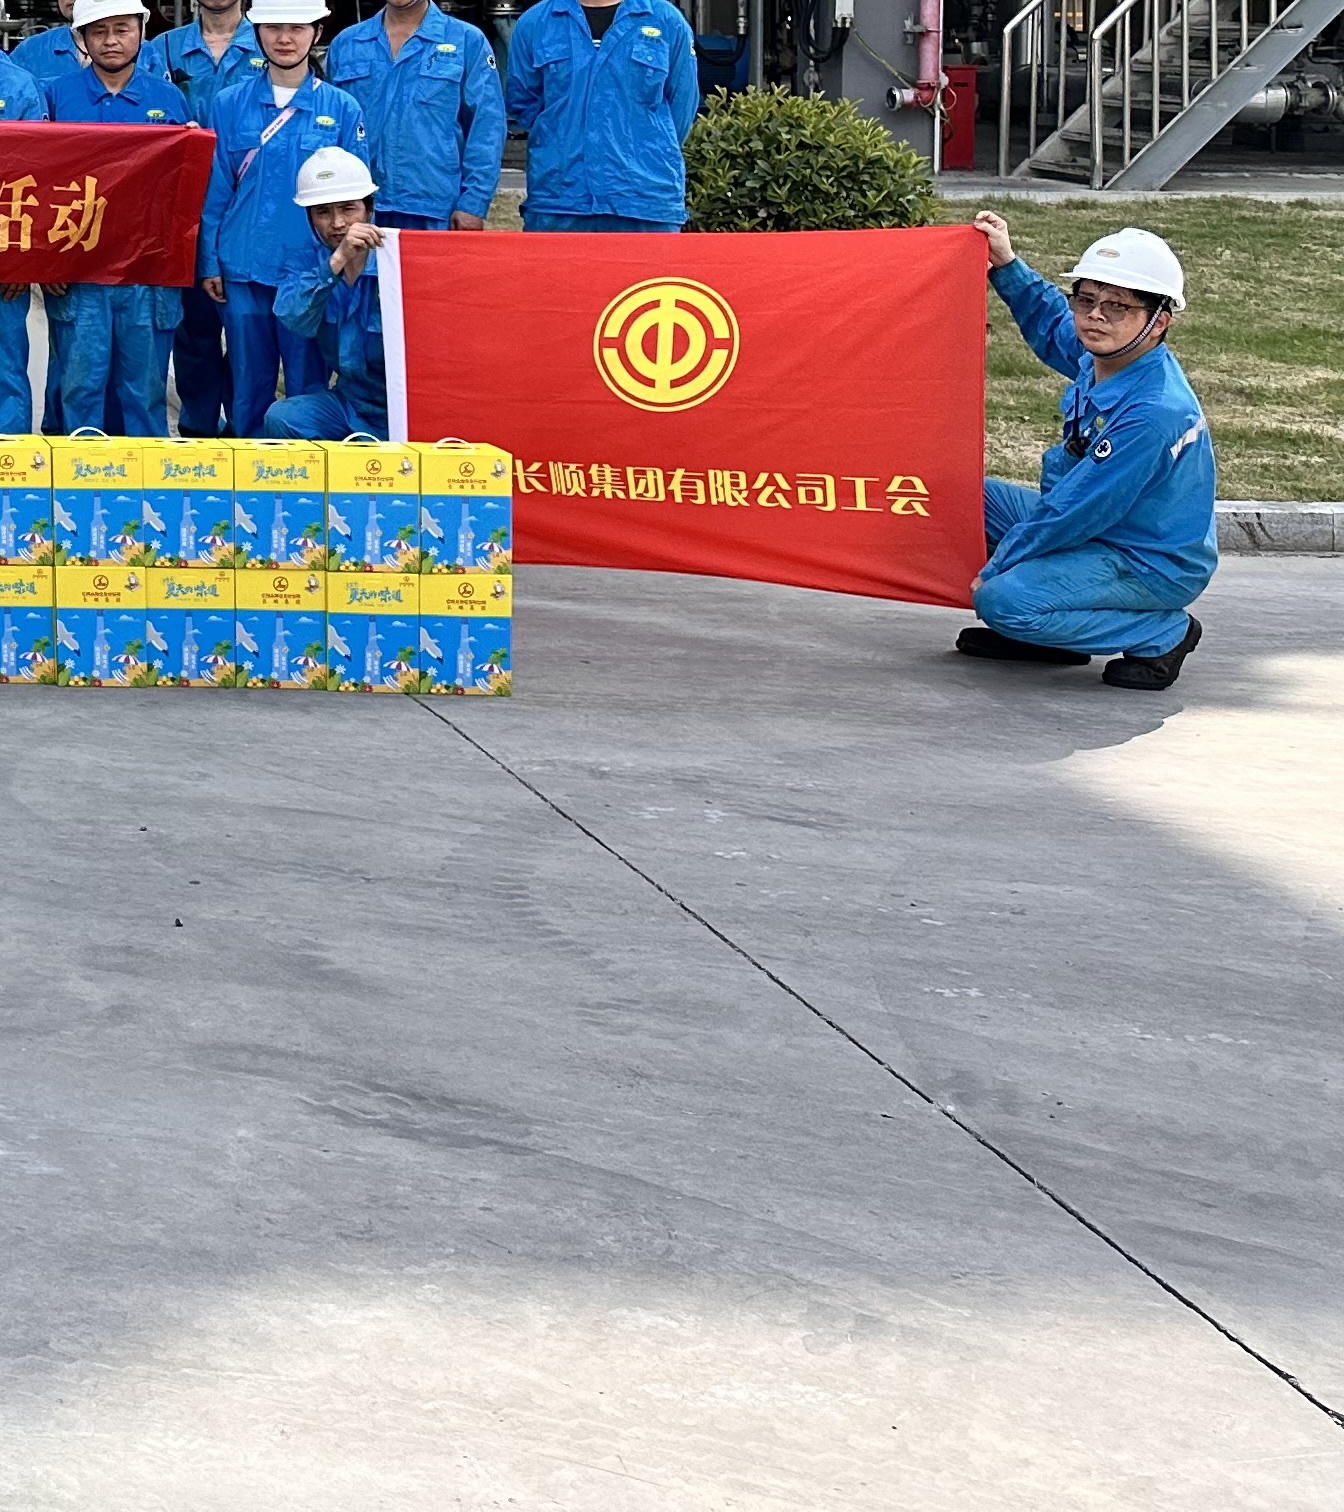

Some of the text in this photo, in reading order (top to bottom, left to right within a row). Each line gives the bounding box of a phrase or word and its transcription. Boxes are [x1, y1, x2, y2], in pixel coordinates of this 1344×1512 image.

[512, 459, 931, 518] 长顺集团有限公司工会
